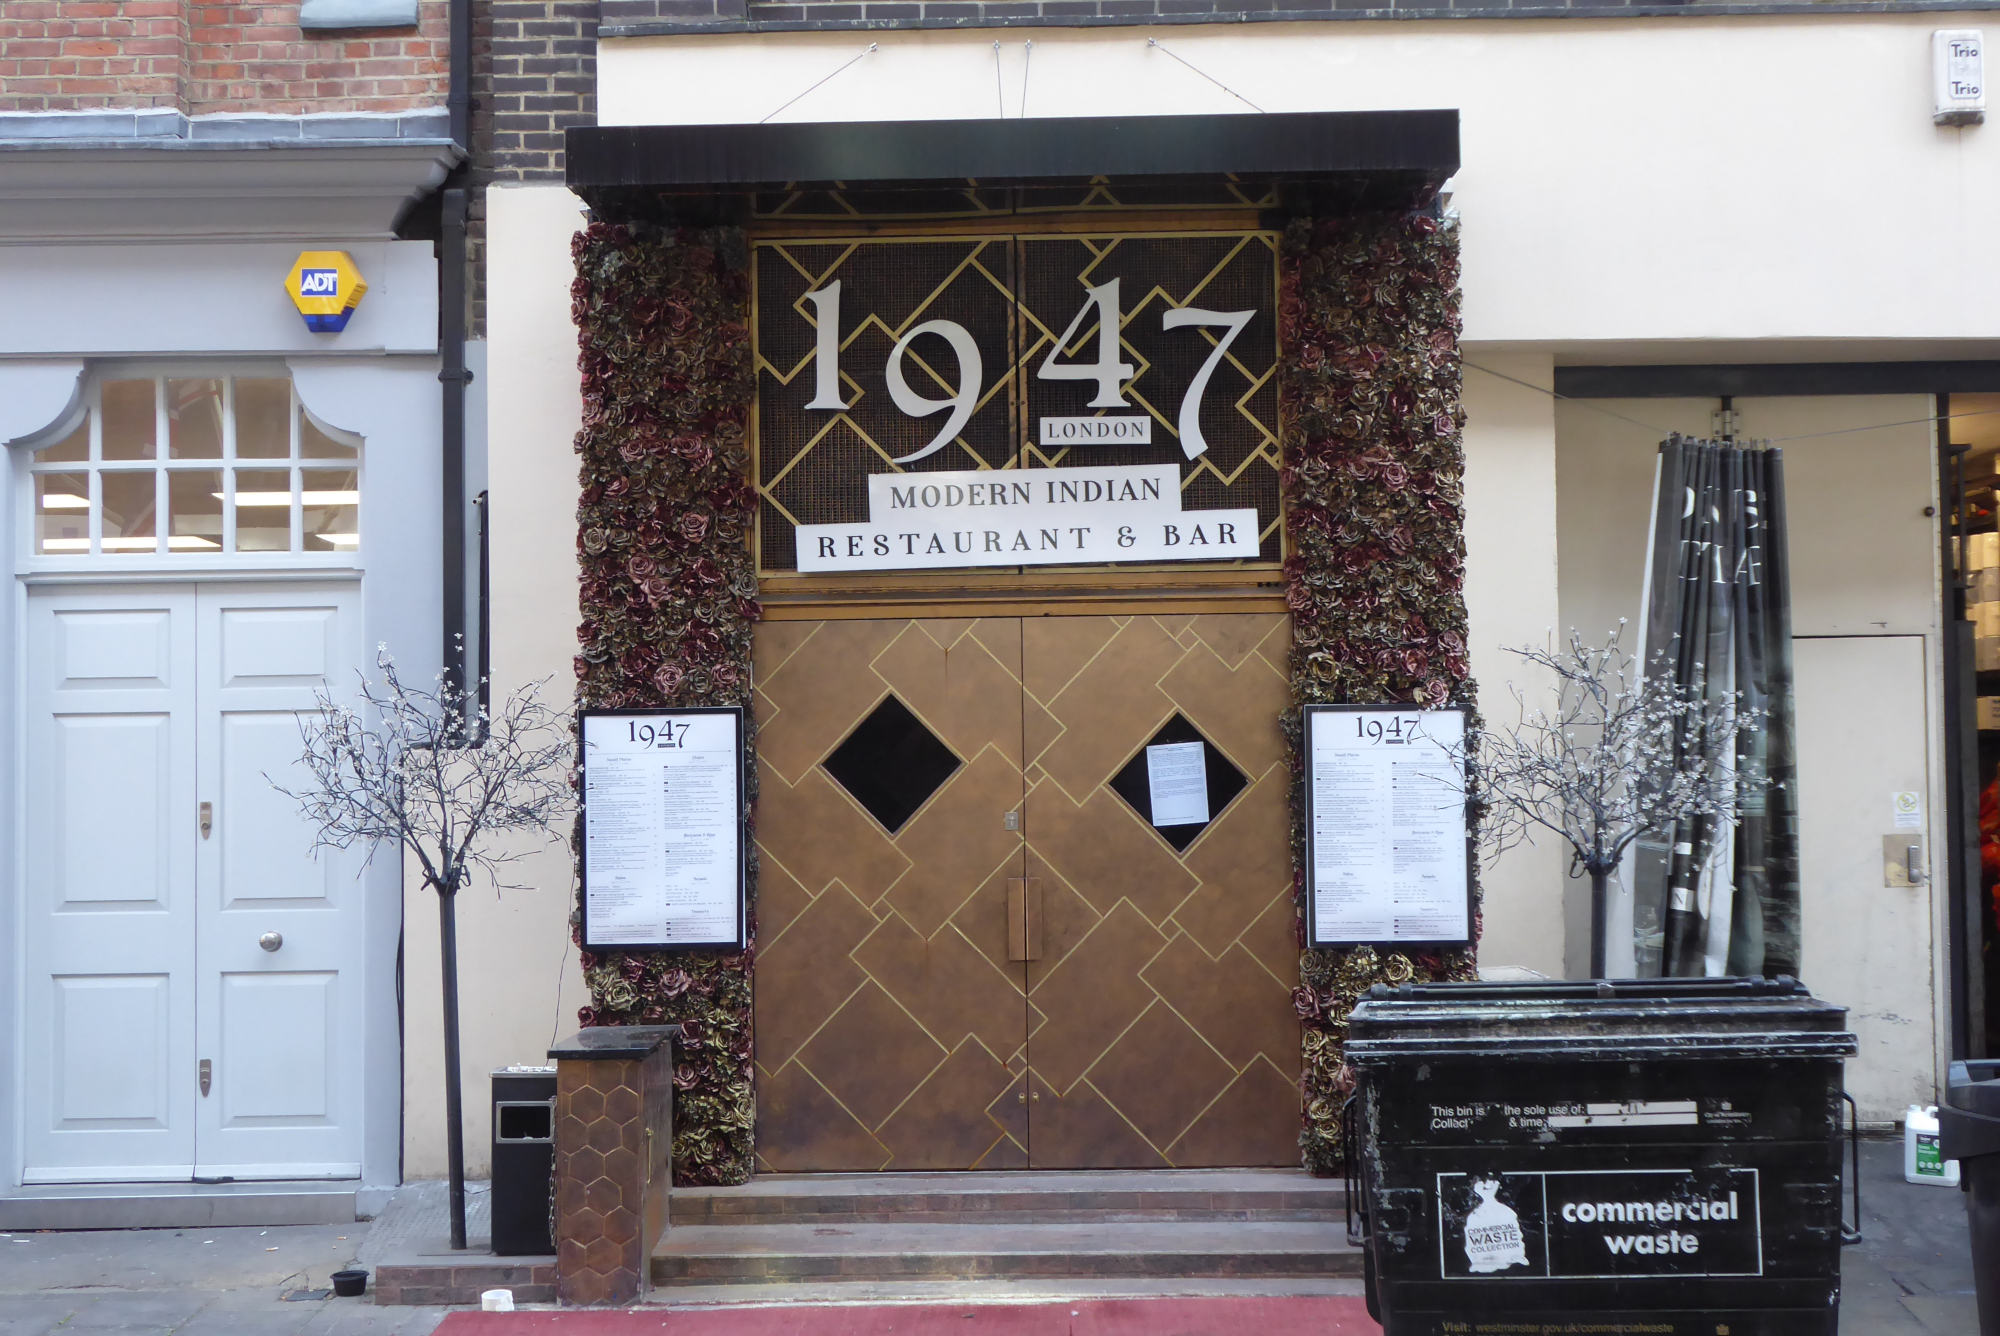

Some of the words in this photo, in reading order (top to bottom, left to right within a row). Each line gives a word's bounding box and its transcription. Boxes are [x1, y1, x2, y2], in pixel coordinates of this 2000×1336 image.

[1951, 44, 1979, 57] Trio
[1952, 81, 1980, 95] Trio
[301, 272, 338, 292] ADT
[803, 277, 1258, 464] 1947
[1047, 421, 1145, 439] LONDON
[889, 482, 1031, 510] MODERN
[1046, 478, 1161, 504] INDIAN
[817, 527, 1092, 558] RESTAURANT
[1116, 525, 1137, 548] &
[1164, 522, 1238, 547] BAR
[628, 719, 691, 750] 1947
[1356, 715, 1419, 746] 1947
[1432, 1106, 1454, 1117] This
[1457, 1106, 1473, 1116] bin
[1475, 1105, 1485, 1115] is
[1504, 1104, 1521, 1115] the
[1523, 1104, 1546, 1115] sole
[1549, 1105, 1568, 1114] use
[1508, 1116, 1518, 1128] &
[1562, 1191, 1738, 1223] commercial
[1468, 1223, 1515, 1236] COMMERCIAL
[1469, 1230, 1519, 1246] WASTE
[1470, 1241, 1520, 1254] COLLECTION
[1604, 1230, 1699, 1254] waste
[1442, 1321, 1471, 1333] Visit:
